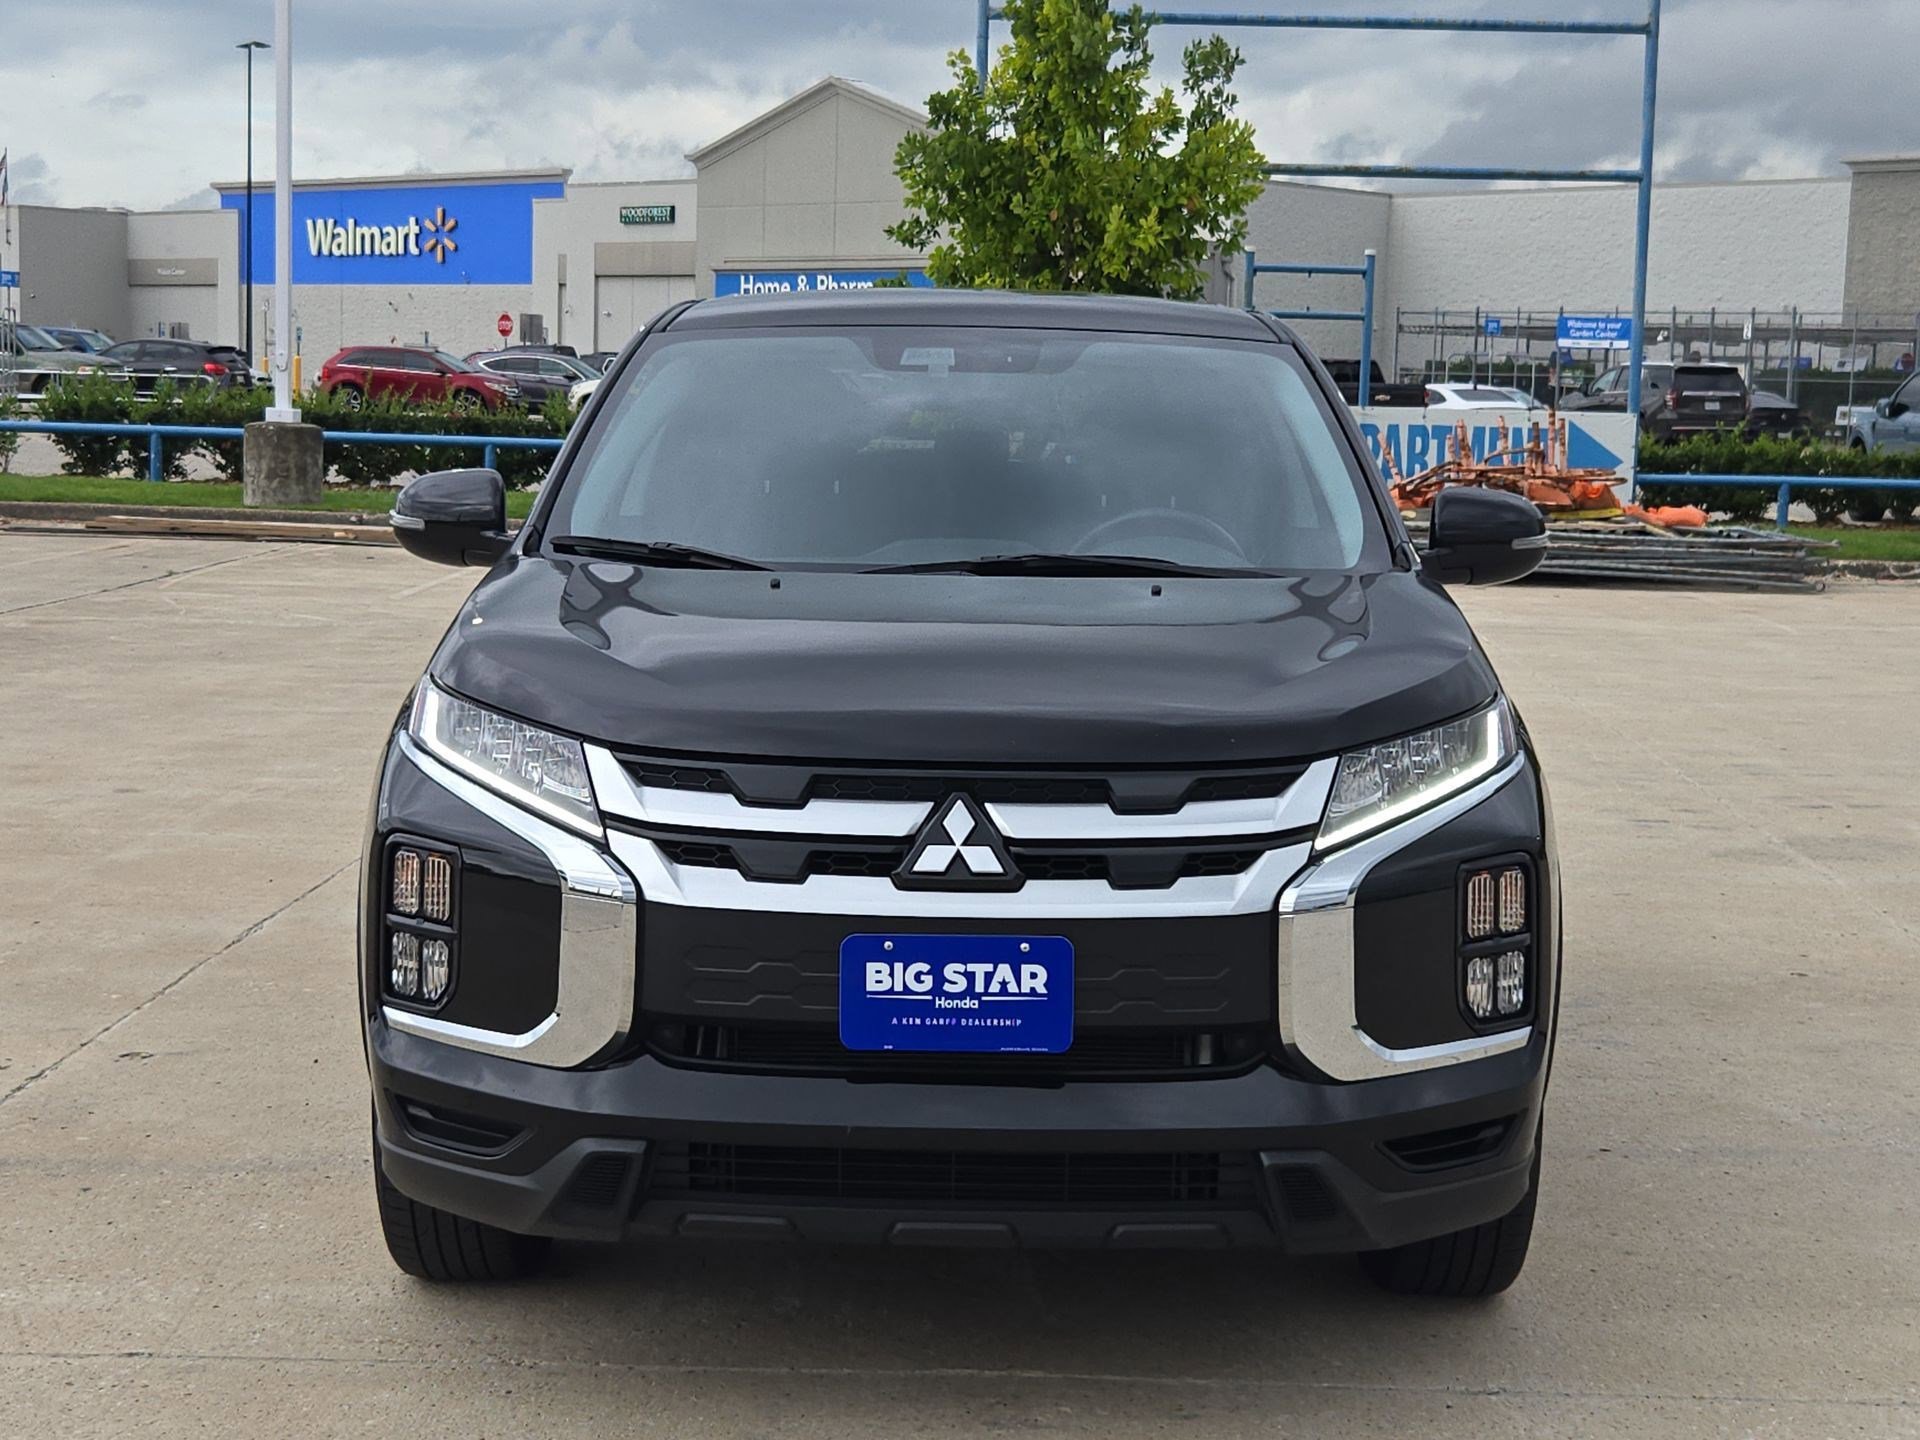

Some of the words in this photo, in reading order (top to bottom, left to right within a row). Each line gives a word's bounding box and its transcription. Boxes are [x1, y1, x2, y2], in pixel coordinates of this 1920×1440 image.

[621, 207, 671, 217] WOODFOREST
[306, 217, 420, 256] Walmart
[740, 274, 791, 295] Home
[797, 274, 809, 292] &
[498, 320, 513, 330] STOP
[1569, 329, 1594, 337] Garden
[1595, 330, 1618, 339] Center
[866, 962, 933, 992] BIG
[942, 963, 1048, 993] STAR
[935, 996, 979, 1009] Honda
[892, 1017, 898, 1025] A
[902, 1017, 921, 1025] KEN
[961, 1018, 1022, 1027] DEALERSHIP
